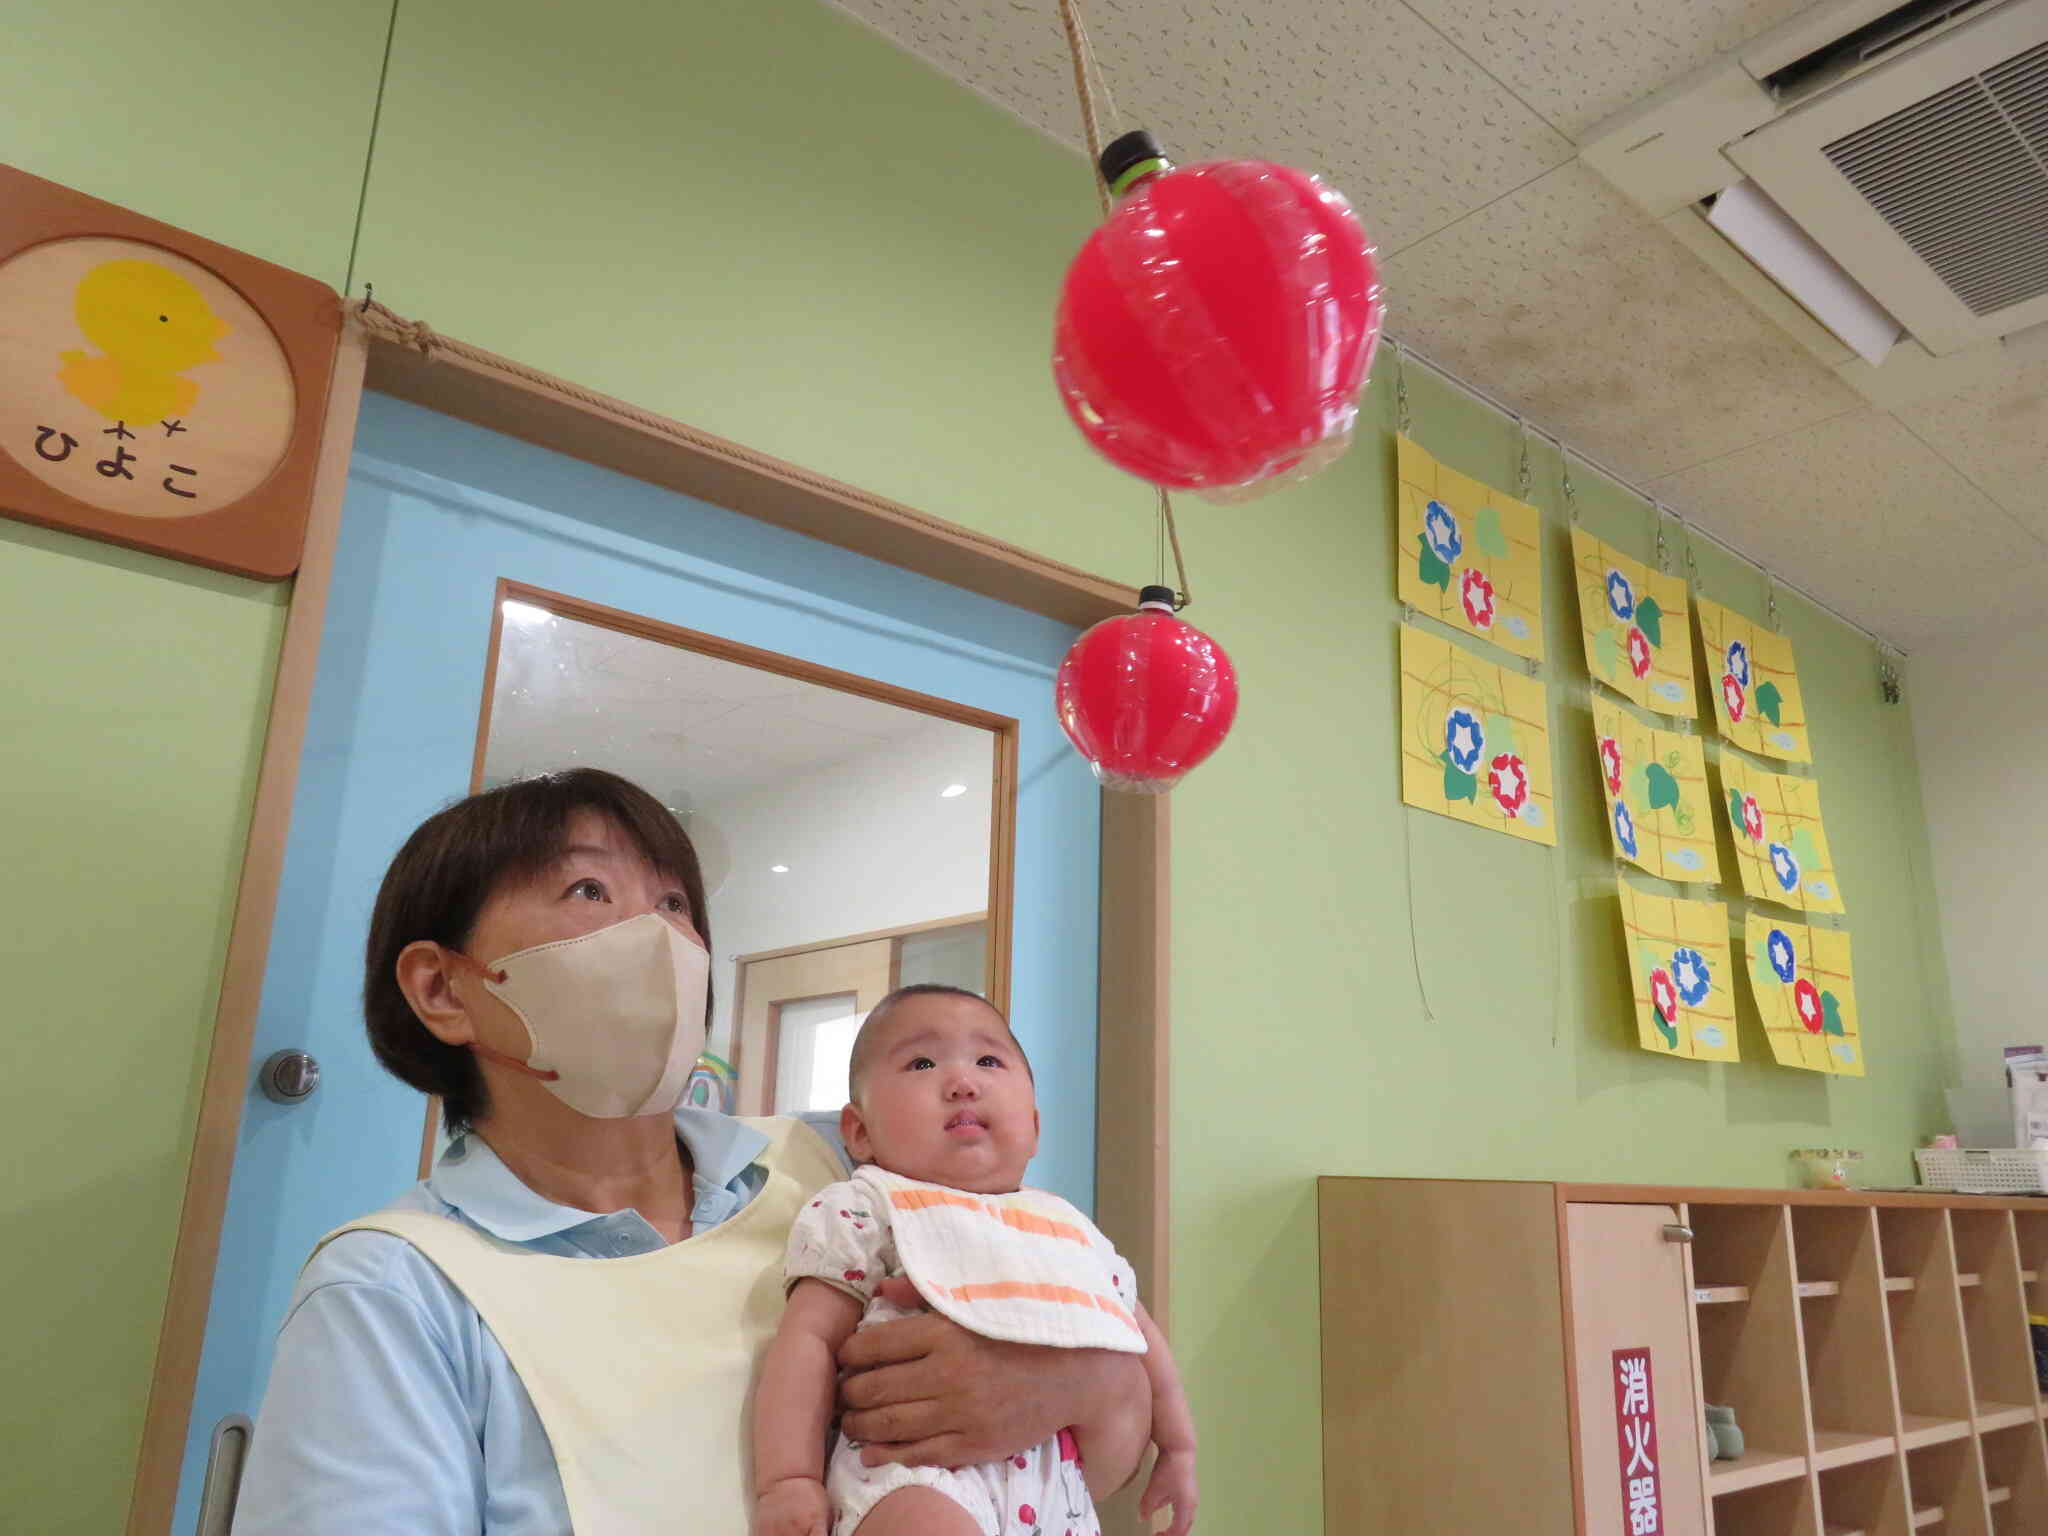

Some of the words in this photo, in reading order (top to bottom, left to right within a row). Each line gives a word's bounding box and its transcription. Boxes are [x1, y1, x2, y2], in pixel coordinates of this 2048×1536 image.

[35, 425, 197, 498] ひよこ
[1620, 1357, 1658, 1535] 消火器
